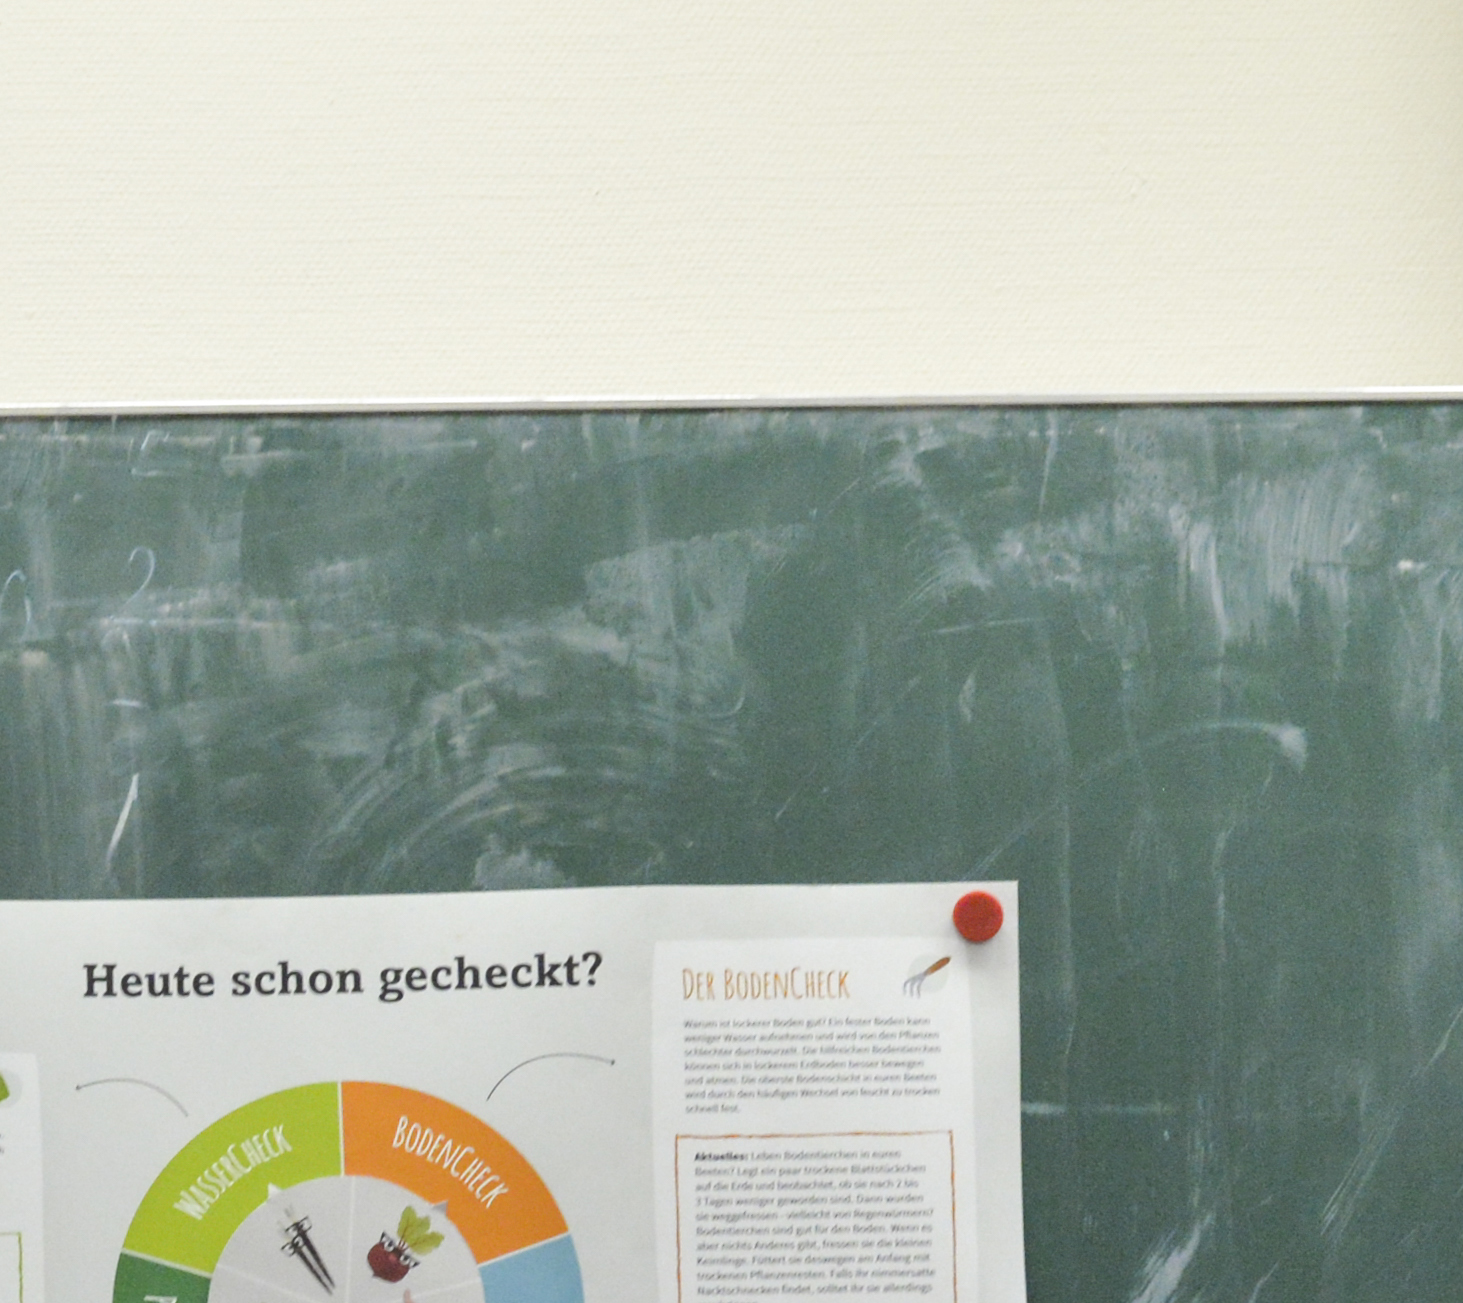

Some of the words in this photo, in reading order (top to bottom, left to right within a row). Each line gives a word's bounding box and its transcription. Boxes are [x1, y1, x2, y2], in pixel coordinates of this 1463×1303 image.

[82, 963, 216, 998] Heute
[231, 960, 364, 997] schon
[377, 951, 604, 1003] gecheckt?
